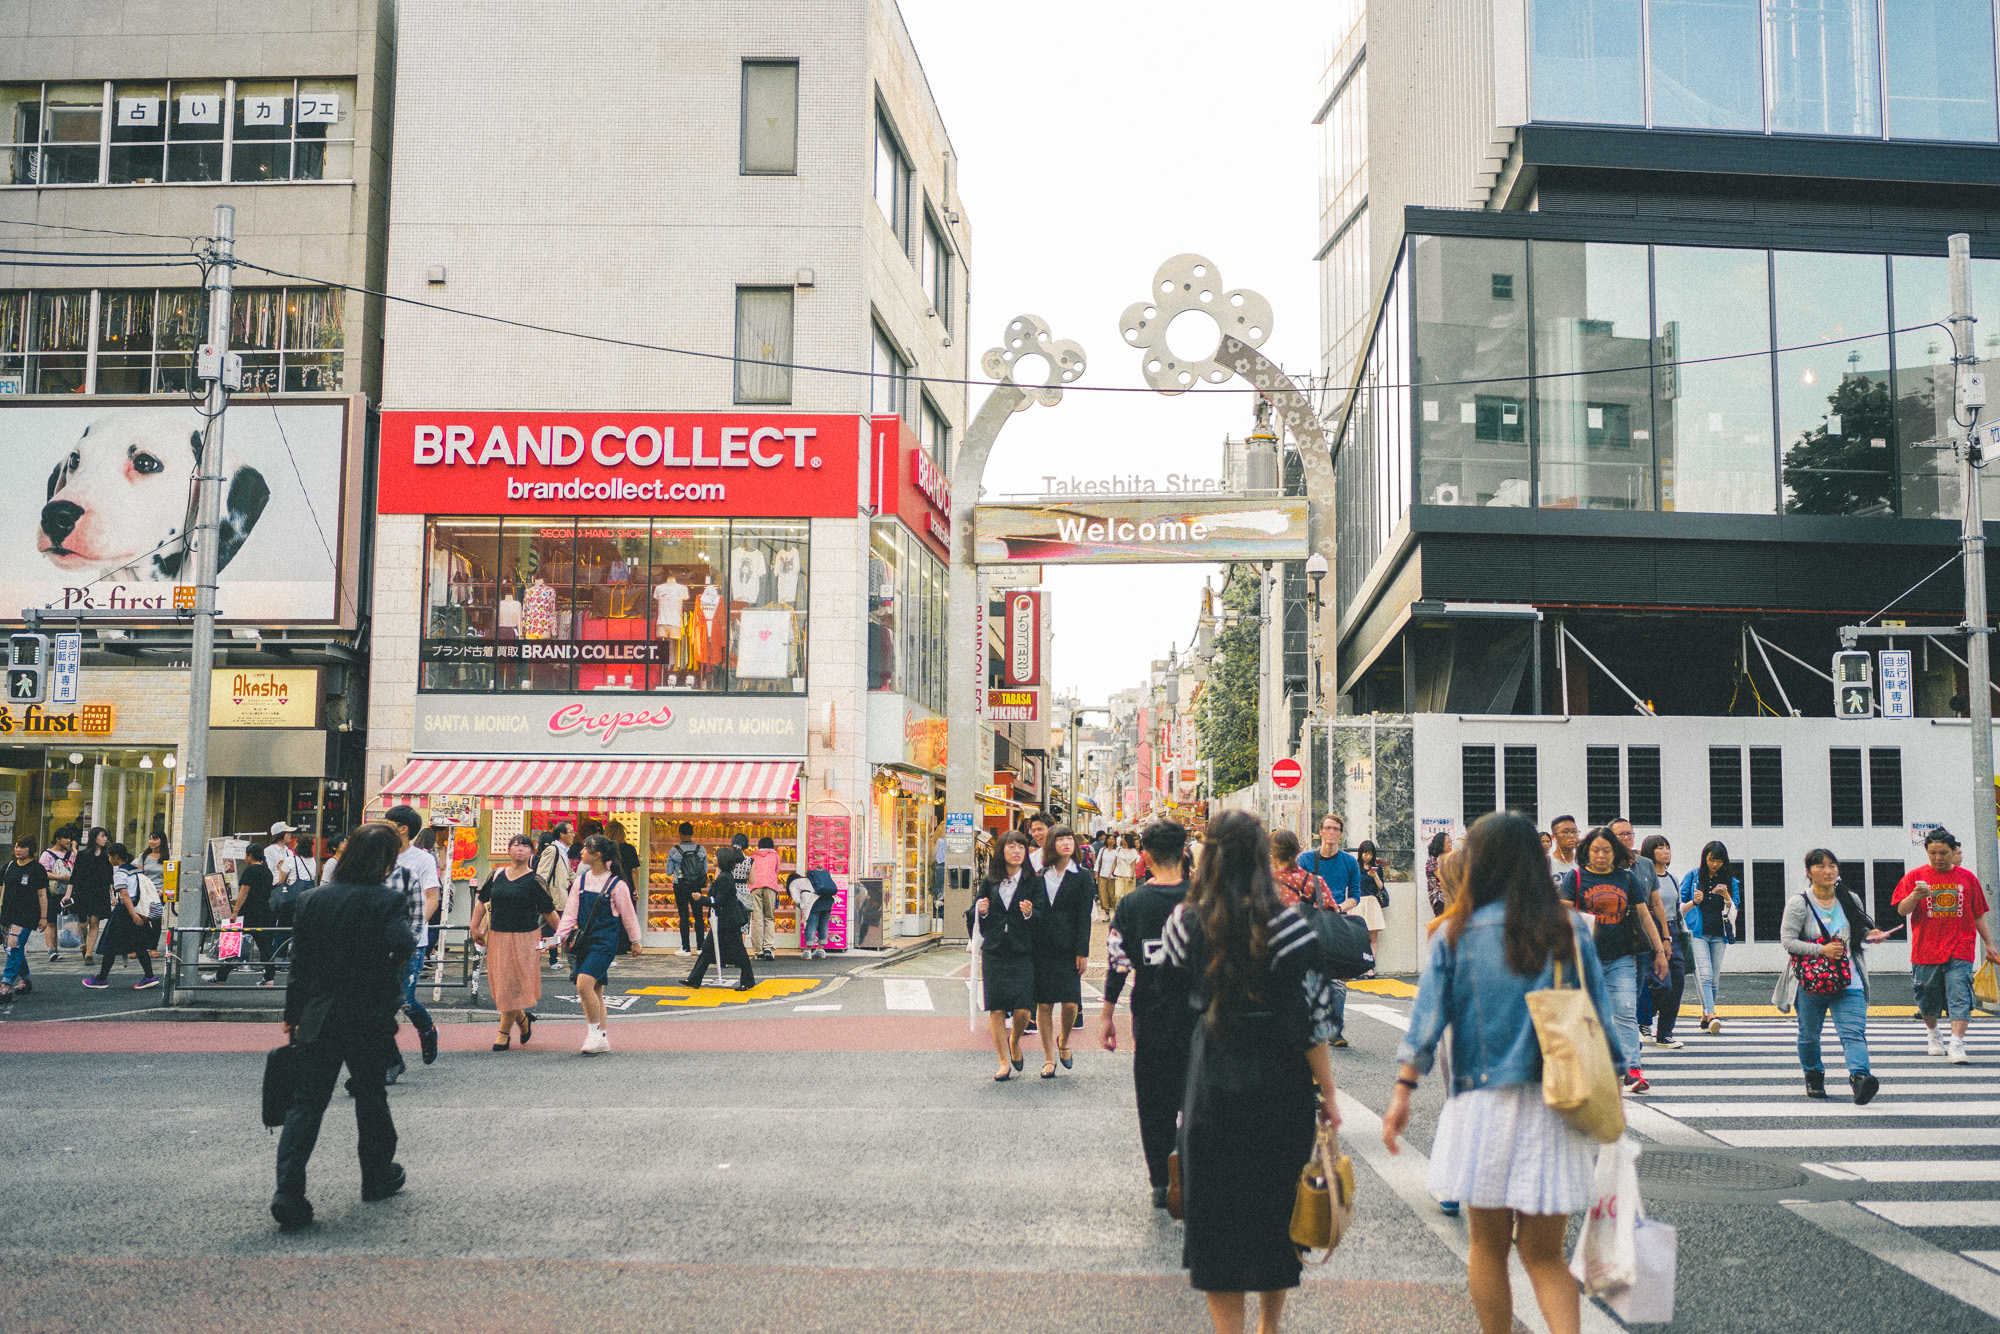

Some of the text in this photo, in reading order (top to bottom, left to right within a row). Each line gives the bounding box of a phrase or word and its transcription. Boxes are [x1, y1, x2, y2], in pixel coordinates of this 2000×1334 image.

[0, 381, 18, 393] PEN
[414, 425, 584, 465] BRAND
[507, 477, 725, 501] brandcollect.com
[1042, 474, 1155, 496] Takeshita
[584, 529, 615, 538] HAND
[616, 529, 644, 538] SHOP
[669, 529, 693, 538] FREE
[1056, 518, 1208, 542] Welcome
[57, 639, 67, 674] 自転車
[67, 639, 78, 674] 歩行者
[432, 645, 494, 657] ブランド古着
[497, 645, 519, 658] 買取
[521, 645, 579, 659] BRAND
[1017, 612, 1029, 681] LOTTERIA
[233, 673, 288, 697] Akasha
[1883, 656, 1895, 690] 自転車
[1896, 656, 1908, 691] 歩行者
[60, 675, 70, 698] 専用
[1001, 692, 1032, 705] TABASA
[988, 706, 1033, 720] VIKING!
[1891, 691, 1903, 714] 専用
[424, 714, 529, 732] SANTA MONICA
[548, 703, 672, 742] Crepes
[688, 717, 795, 735] SANTA MONICA
[1185, 718, 1194, 766] ゼンモール
